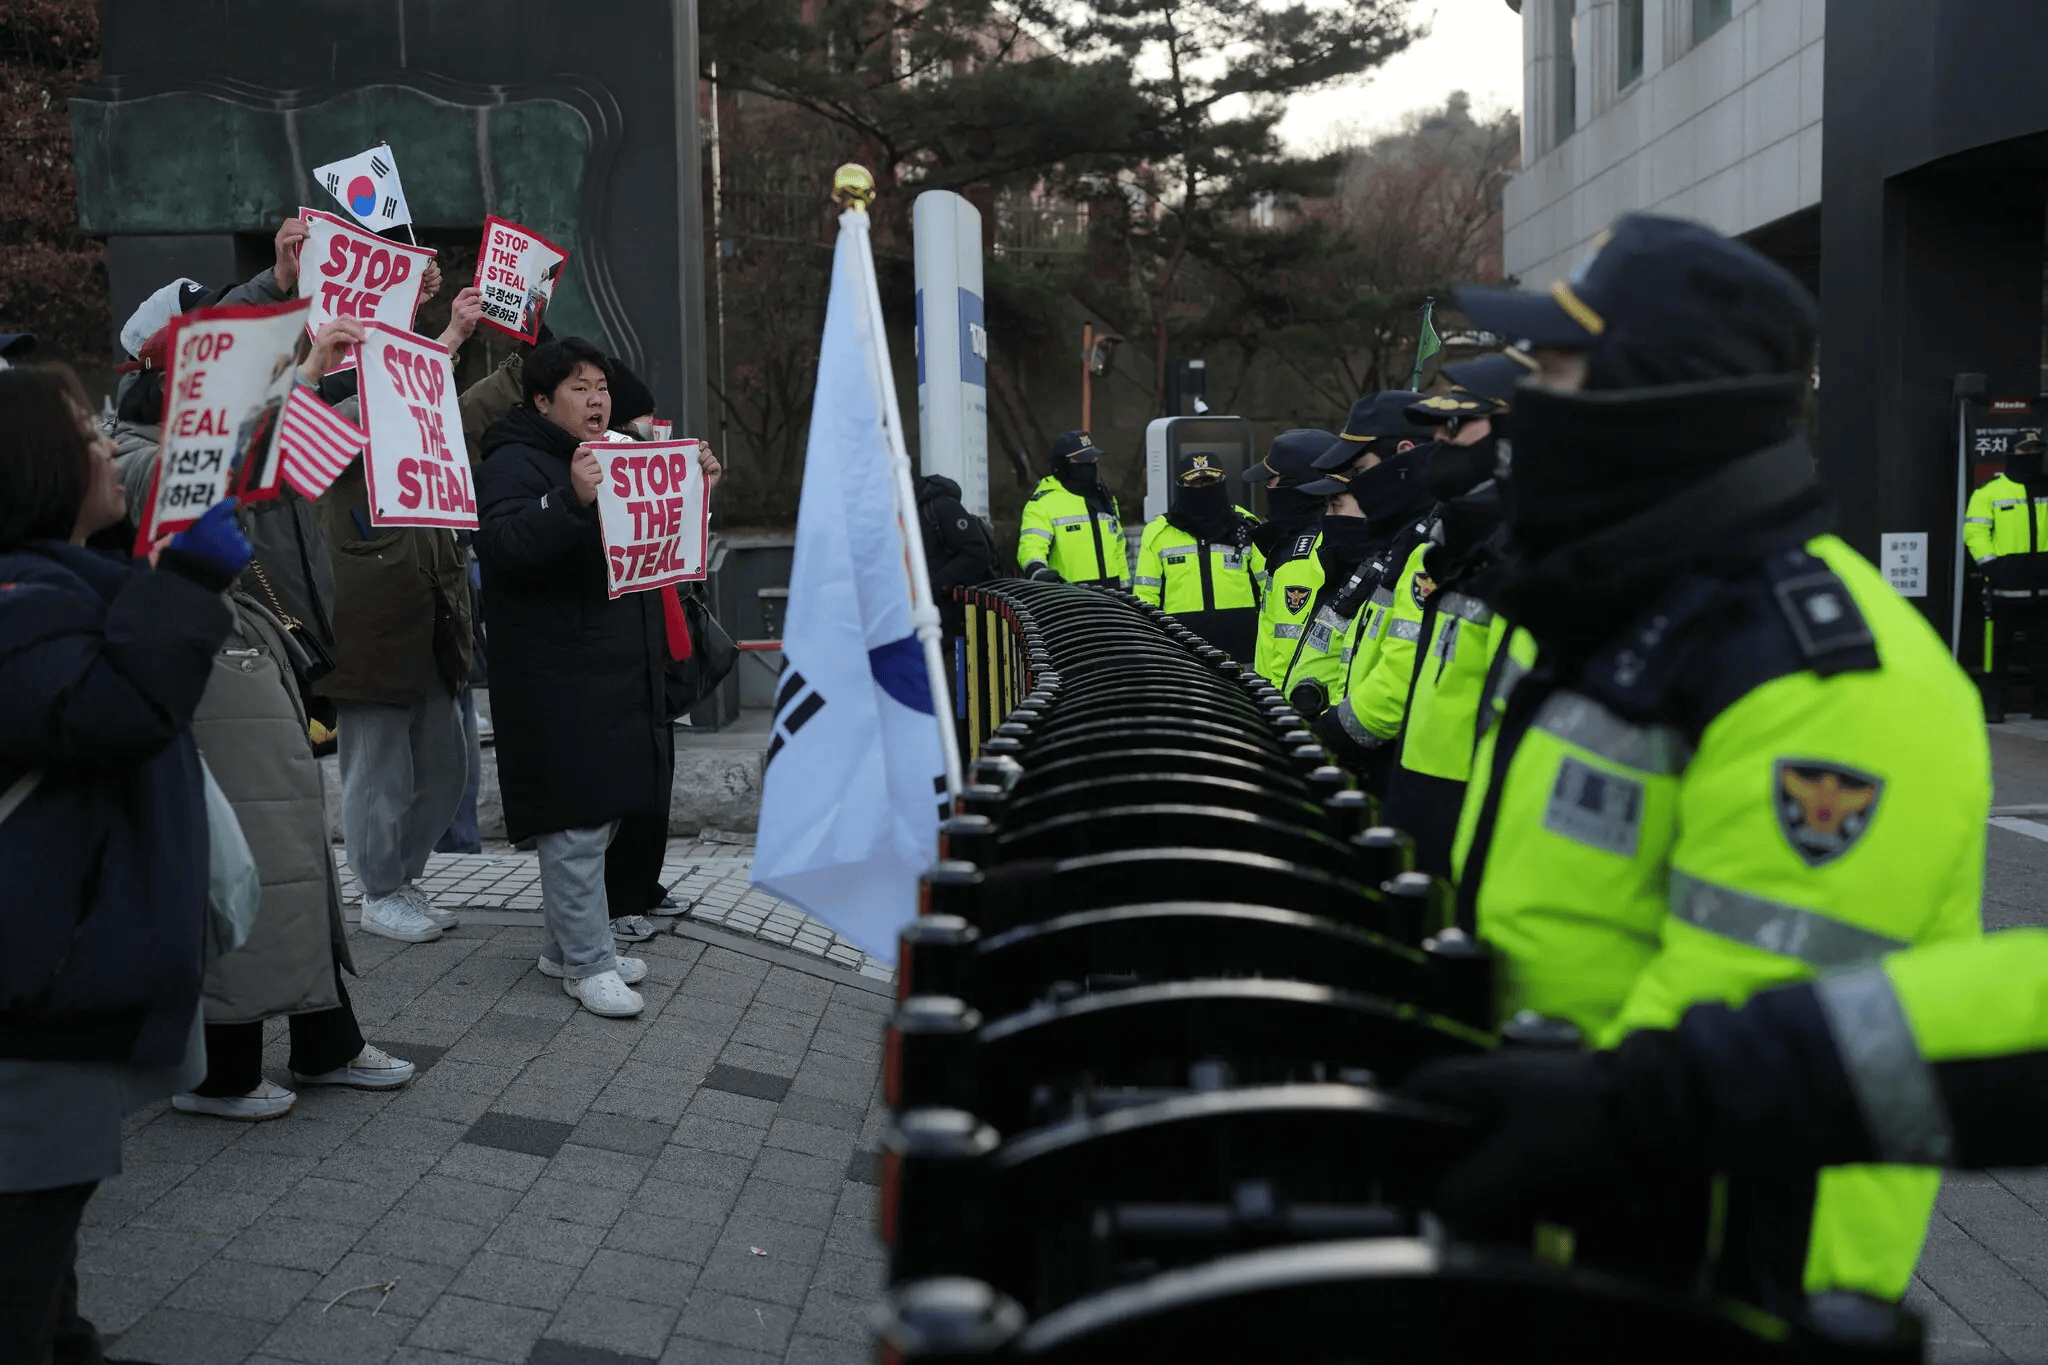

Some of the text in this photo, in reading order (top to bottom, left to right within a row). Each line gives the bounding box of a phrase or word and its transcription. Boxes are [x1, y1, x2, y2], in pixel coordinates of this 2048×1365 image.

[320, 233, 411, 292] STOP
[491, 248, 518, 269] THE
[494, 230, 528, 253] STOP
[320, 280, 382, 318] THE
[485, 284, 522, 309] 부정선거
[486, 266, 526, 291] STEAL
[383, 343, 445, 408] STOP
[407, 403, 454, 461] THE
[397, 457, 476, 513] STEAL
[610, 453, 687, 498] STOP
[626, 497, 684, 541] THE
[609, 536, 685, 582] STEAL
